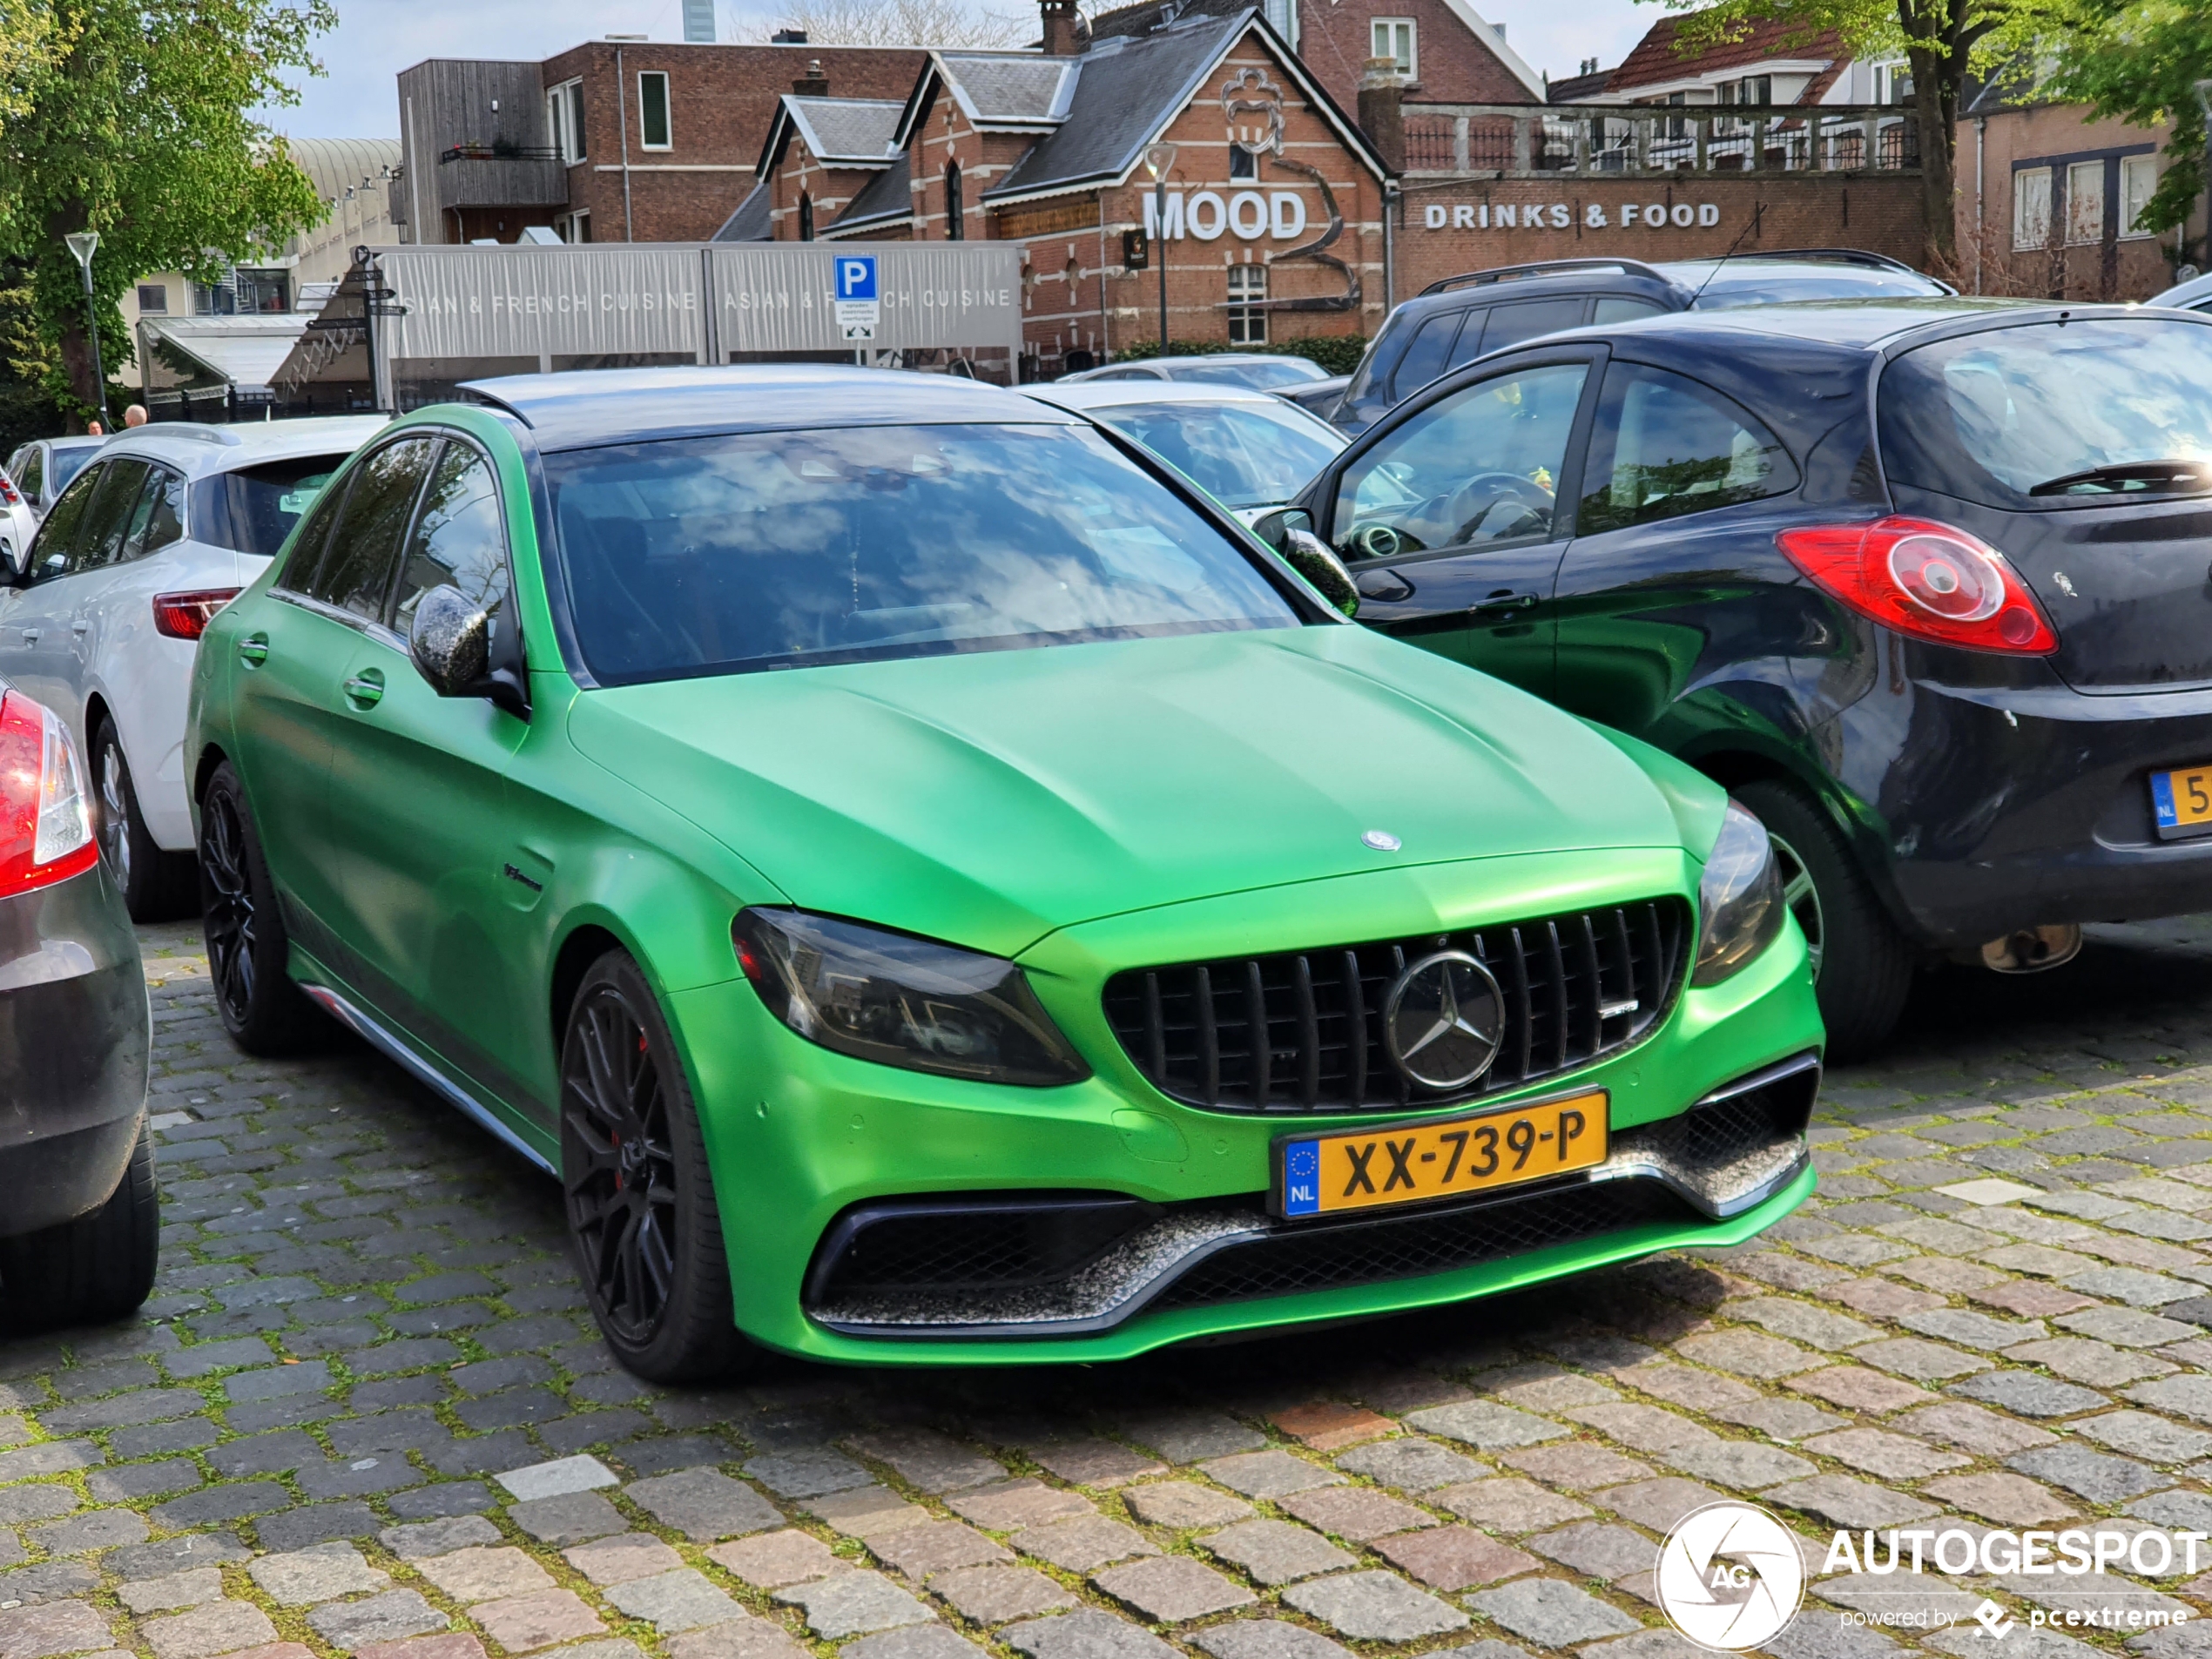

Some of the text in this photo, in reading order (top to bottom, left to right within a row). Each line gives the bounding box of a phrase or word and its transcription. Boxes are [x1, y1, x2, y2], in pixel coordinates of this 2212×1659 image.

[1143, 191, 1305, 240] MOOD
[1425, 204, 1720, 229] DRINKS & FOOD
[844, 261, 867, 295] P
[469, 296, 481, 314] &
[493, 294, 588, 314] FRENCH
[601, 292, 696, 312] CUISINE
[725, 293, 789, 310] ASIAN
[802, 292, 813, 308] &
[922, 288, 1011, 307] CUISINE
[2157, 805, 2175, 818] NL
[1342, 1109, 1586, 1197] XX-739-P
[1291, 1185, 1315, 1204] NL
